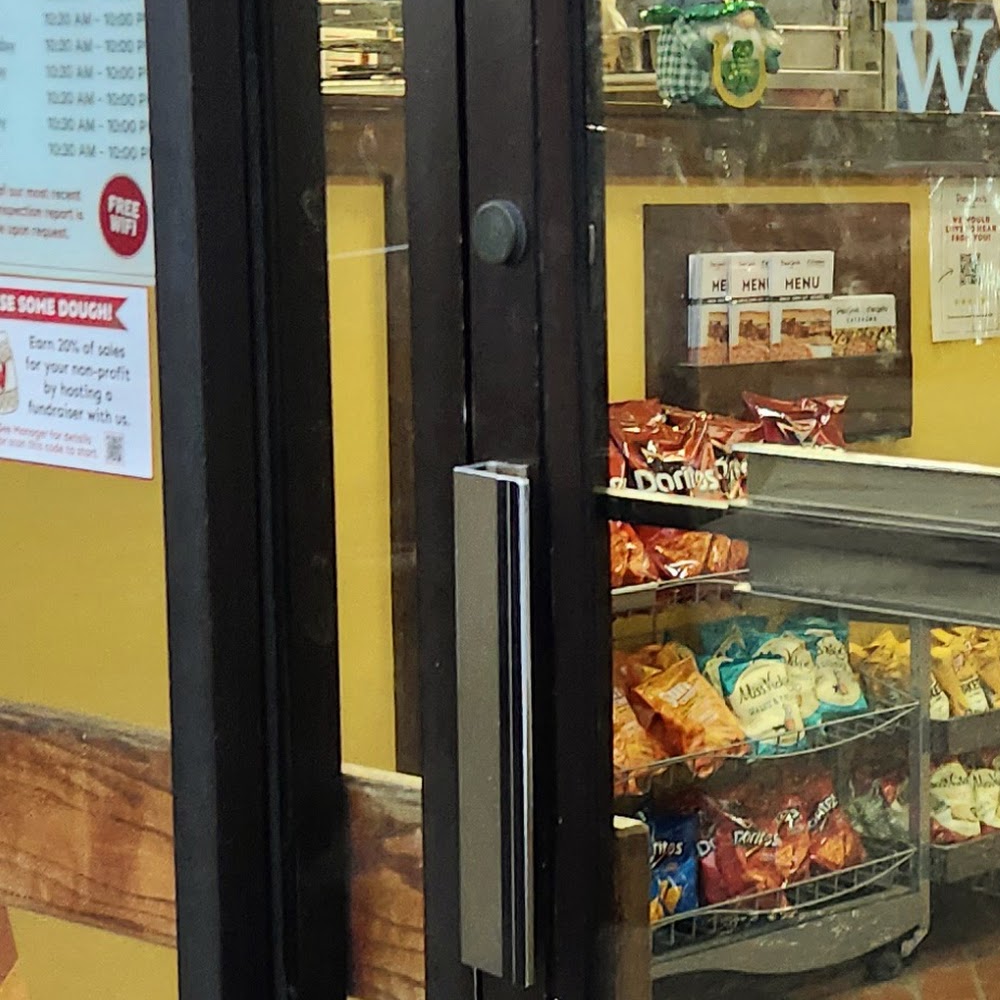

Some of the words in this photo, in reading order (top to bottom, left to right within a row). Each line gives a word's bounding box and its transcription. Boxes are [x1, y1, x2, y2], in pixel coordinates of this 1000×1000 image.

[74, 13, 92, 25] AM
[75, 40, 93, 52] AM
[76, 66, 94, 79] AM
[77, 92, 95, 105] AM
[78, 118, 95, 132] AM
[78, 144, 96, 158] AM
[107, 194, 141, 220] FREE
[712, 280, 726, 293] ME
[785, 276, 820, 290] MENU
[18, 296, 56, 316] SOME
[58, 299, 114, 322] DOUGH!
[29, 336, 54, 352] Earn
[58, 338, 80, 354] 20%
[83, 340, 95, 354] of
[98, 343, 126, 358] sales
[26, 356, 41, 372] for
[45, 362, 69, 376] your
[72, 364, 131, 382] non-profit
[44, 382, 56, 398] by
[60, 382, 102, 405] hosting
[28, 400, 84, 420] fundraiser
[88, 408, 112, 424] with
[115, 415, 131, 427] us.
[634, 465, 720, 493] Doritos
[734, 829, 783, 847] Doritos
